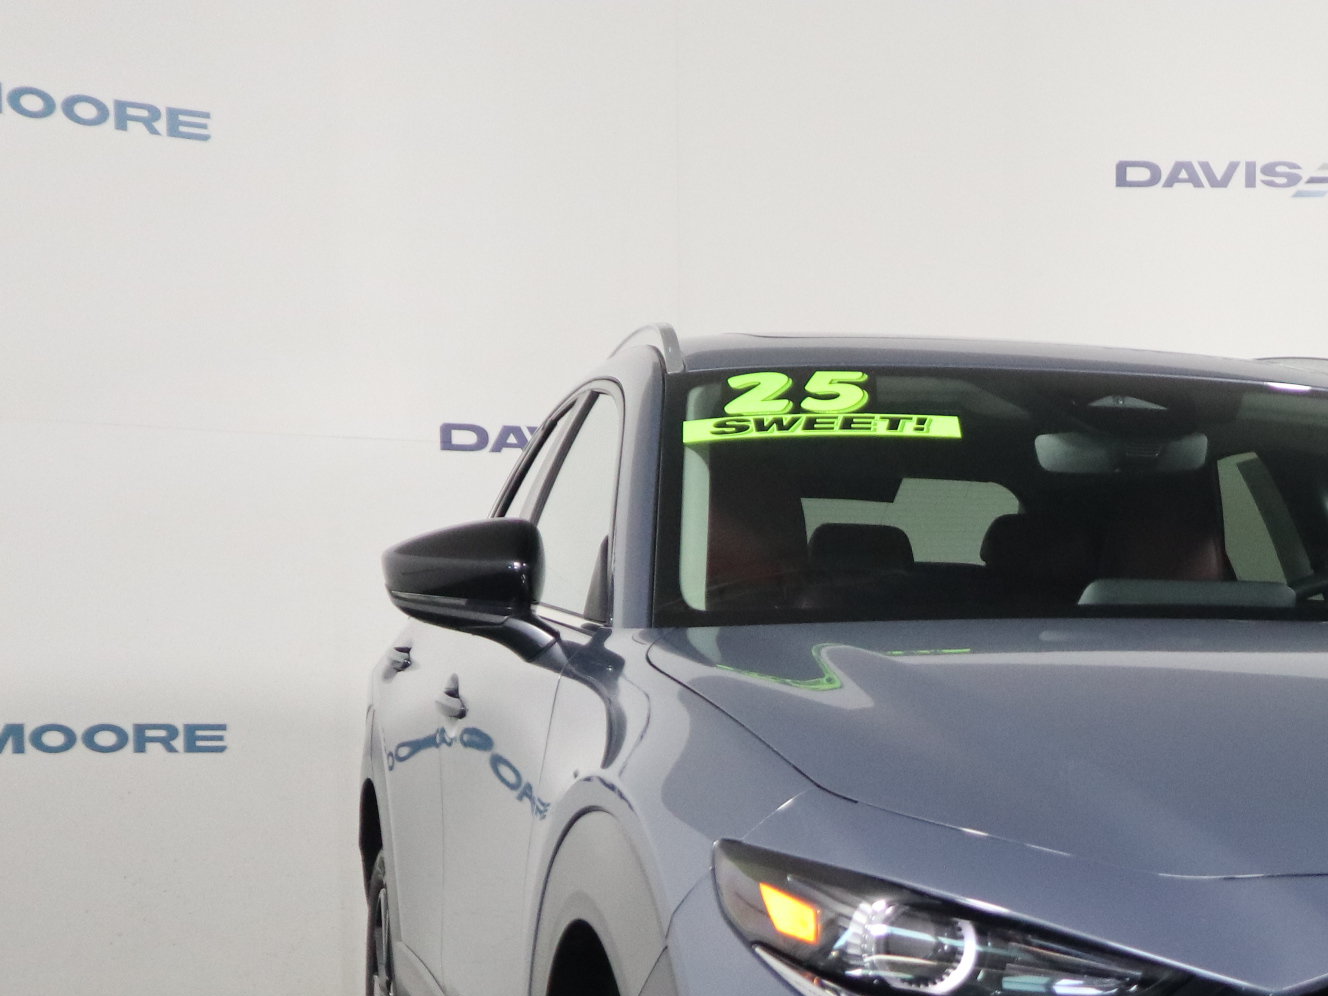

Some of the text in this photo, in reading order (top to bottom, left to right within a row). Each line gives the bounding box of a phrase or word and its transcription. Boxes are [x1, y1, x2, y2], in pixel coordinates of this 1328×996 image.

[0, 82, 211, 142] OORE
[1114, 160, 1303, 189] DAVIS
[723, 370, 869, 415] 25
[439, 422, 538, 453] DA
[710, 414, 932, 436] SWEET!
